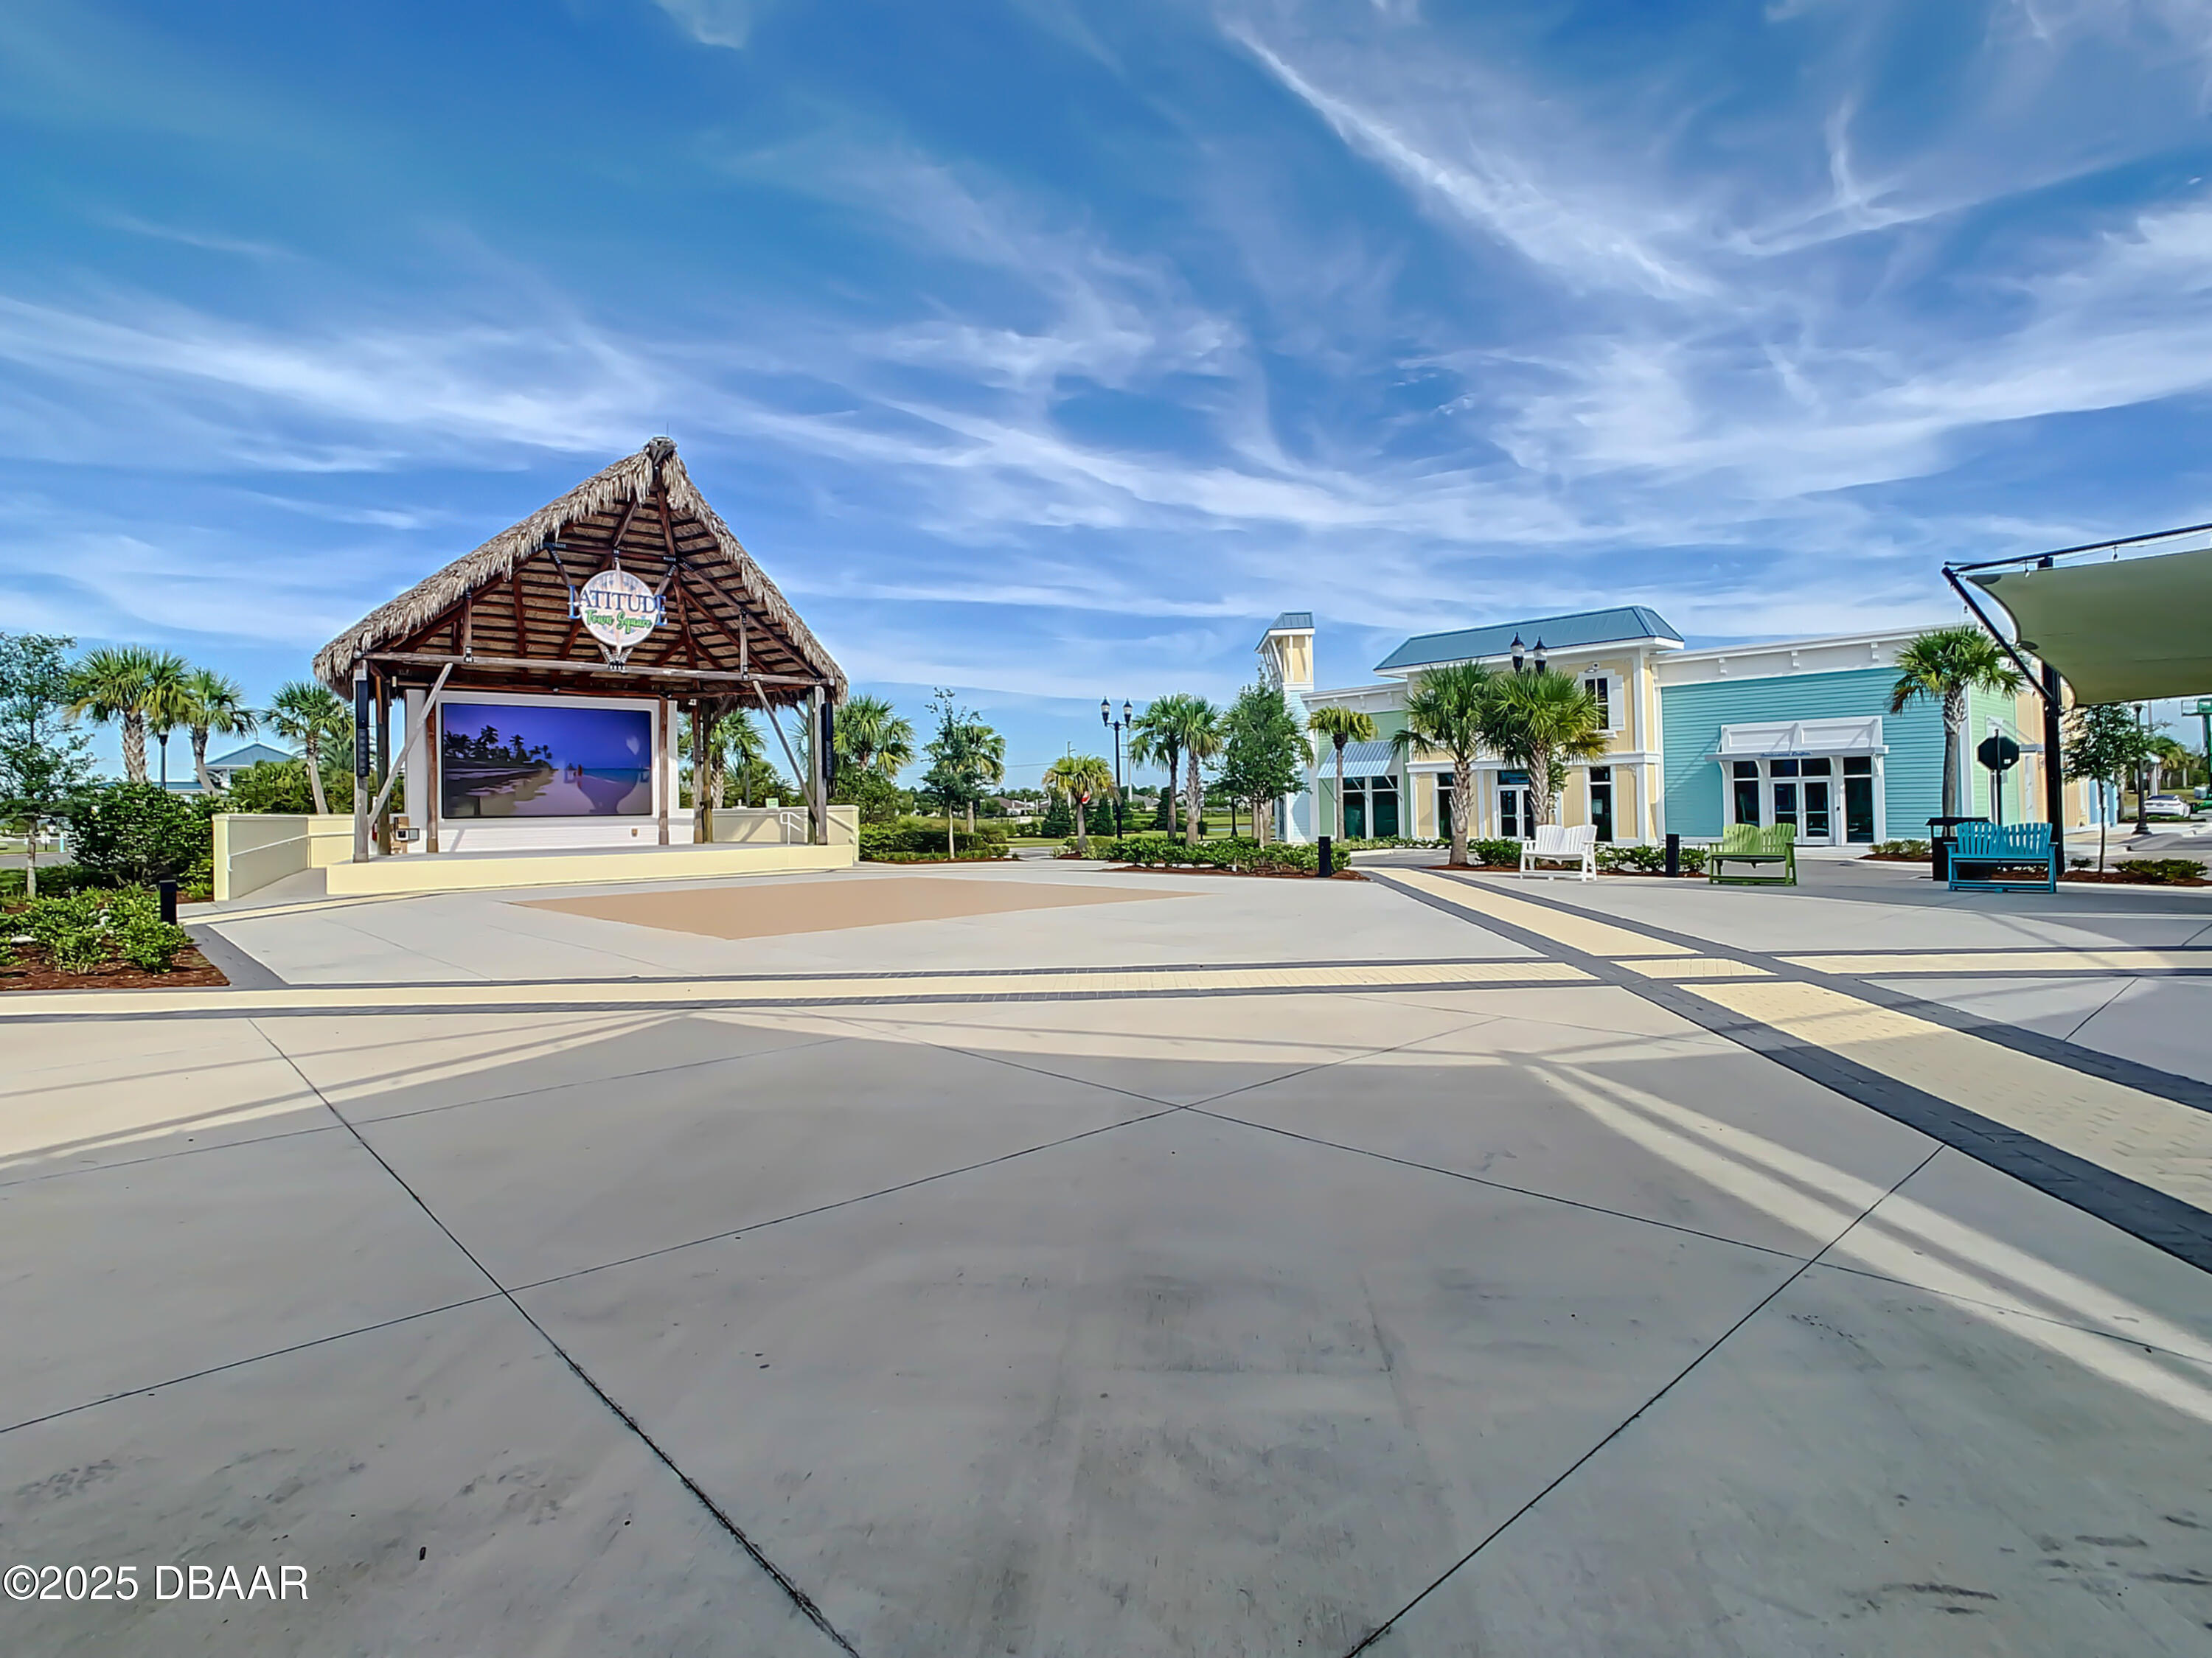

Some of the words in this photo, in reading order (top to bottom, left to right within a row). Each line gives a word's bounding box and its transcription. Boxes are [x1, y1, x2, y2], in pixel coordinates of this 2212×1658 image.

[567, 585, 668, 626] LATITUDE
[585, 609, 614, 626] Town
[616, 611, 652, 635] Square
